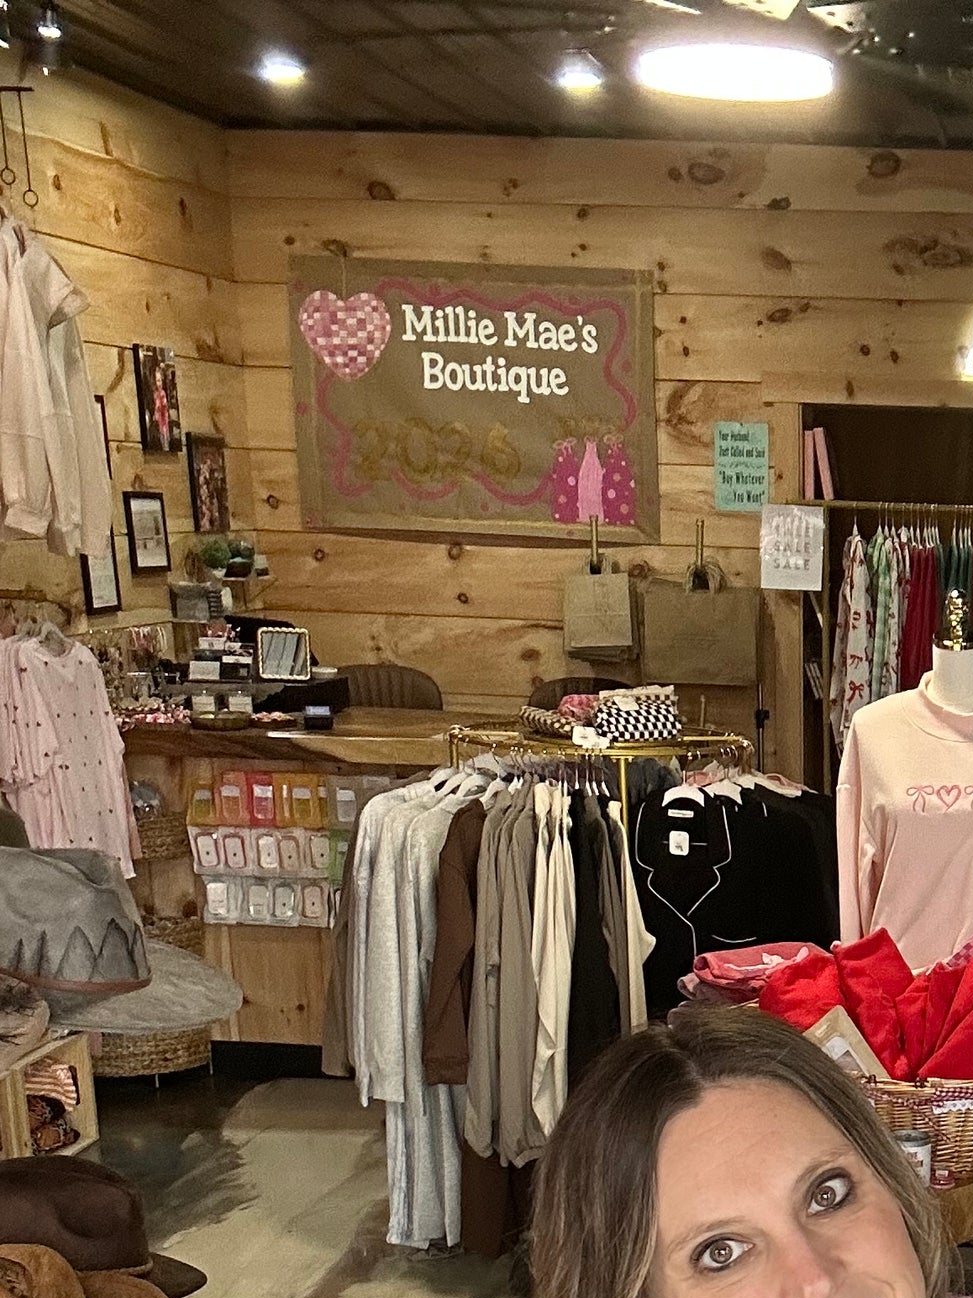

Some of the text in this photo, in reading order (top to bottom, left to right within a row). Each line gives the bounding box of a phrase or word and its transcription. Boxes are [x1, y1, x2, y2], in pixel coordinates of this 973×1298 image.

[401, 304, 599, 354] Millie Mae's
[421, 351, 570, 404] Boutique
[735, 471, 765, 485] Whatever
[774, 540, 811, 553] SALE
[773, 558, 811, 570] SALE
